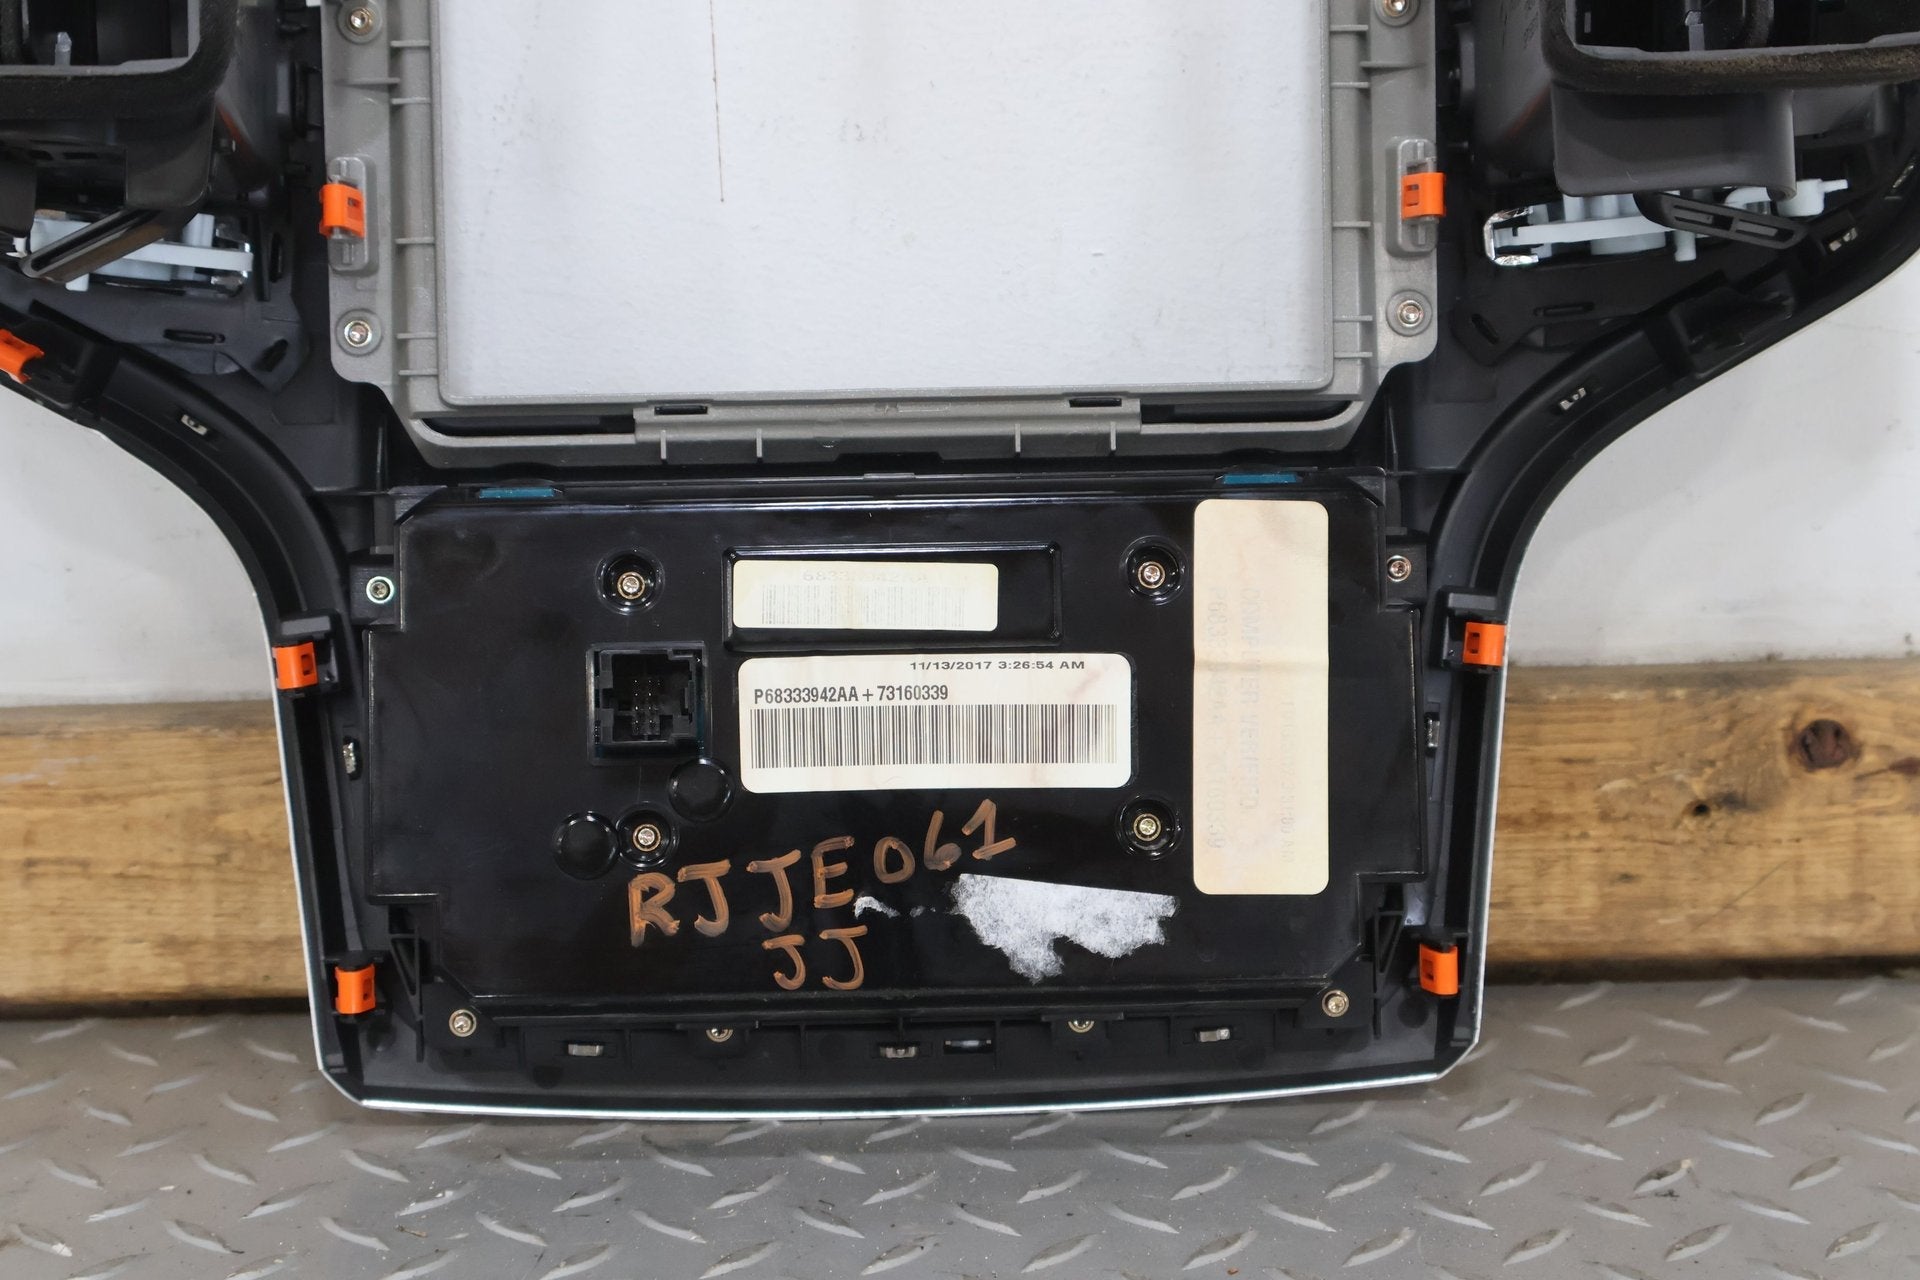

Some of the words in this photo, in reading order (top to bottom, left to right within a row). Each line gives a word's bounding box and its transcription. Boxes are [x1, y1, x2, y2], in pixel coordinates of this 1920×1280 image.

[910, 660, 992, 671] 11/13/2017
[998, 660, 1054, 670] 3:26:54
[1059, 660, 1086, 670] AM
[753, 686, 859, 705] P68333942AA
[877, 685, 949, 701] 73160339
